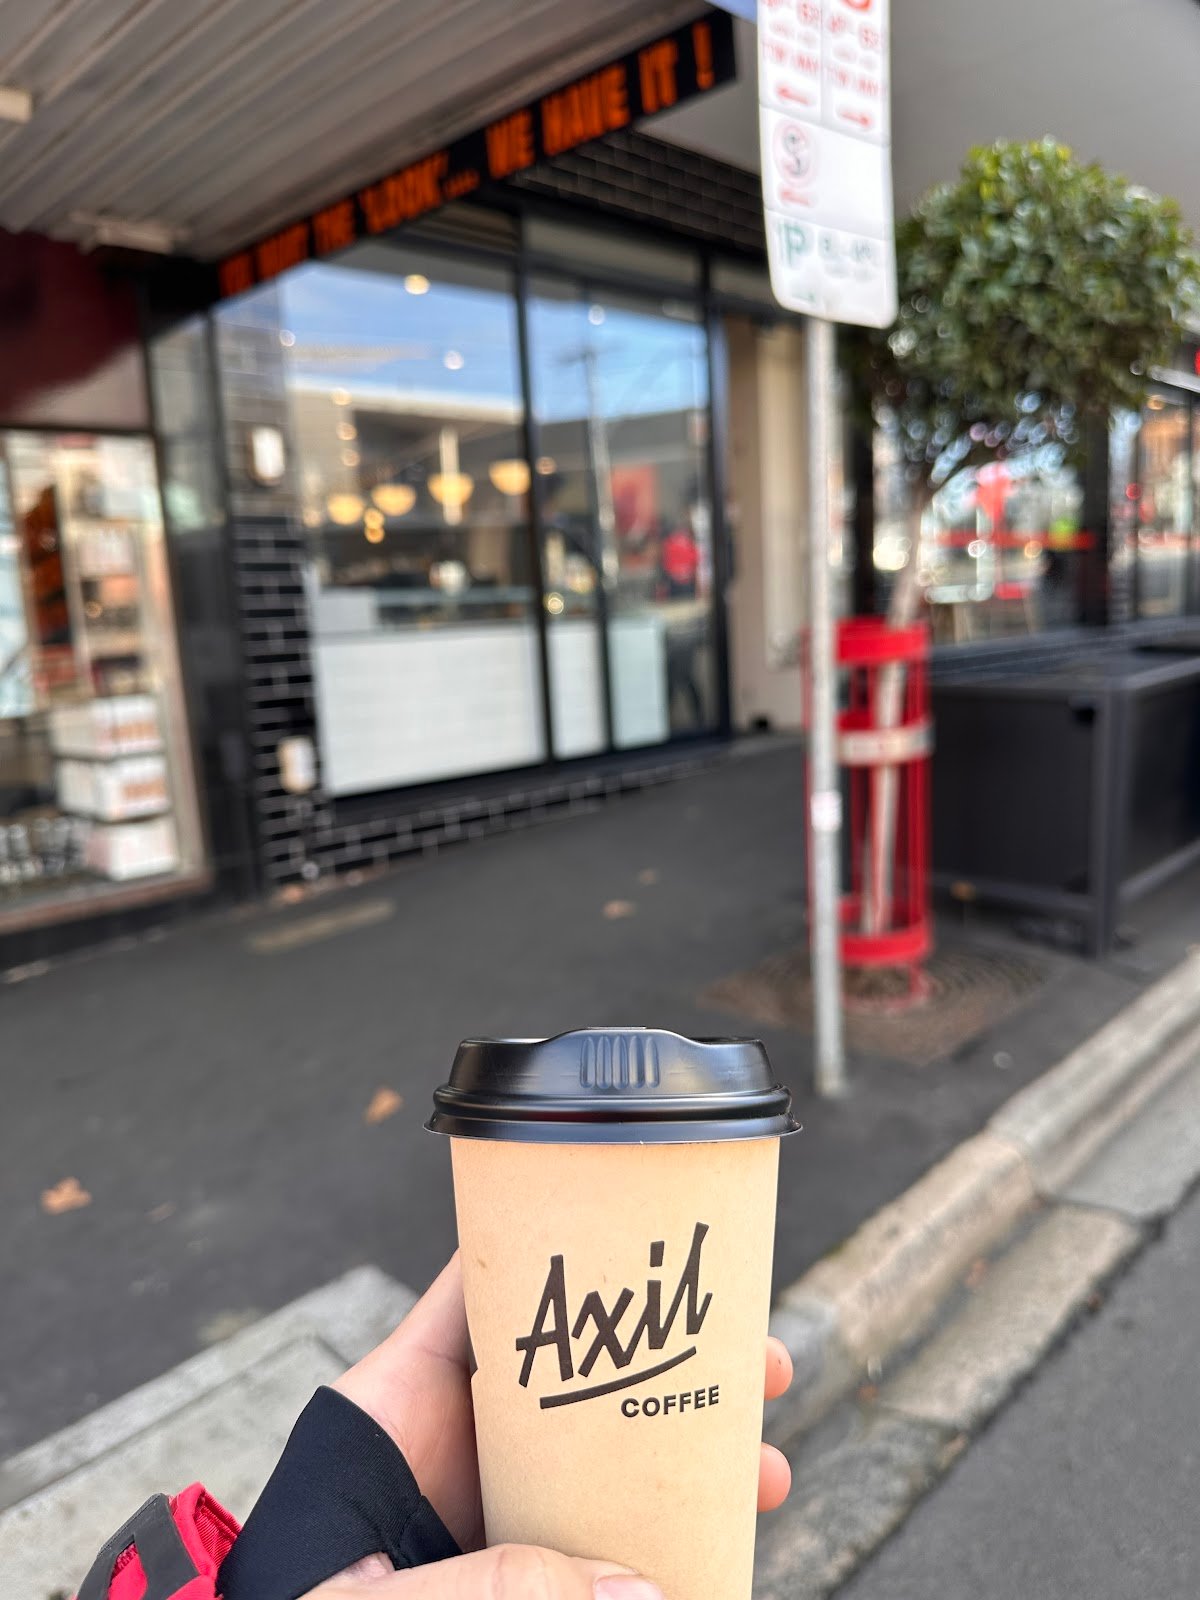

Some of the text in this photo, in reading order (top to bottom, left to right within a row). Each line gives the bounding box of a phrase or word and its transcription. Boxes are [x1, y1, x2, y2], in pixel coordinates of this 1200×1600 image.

[486, 107, 536, 180] WE
[541, 62, 631, 157] HAVE
[637, 38, 678, 115] IT
[692, 22, 715, 90] !
[515, 1221, 714, 1389] Axil
[620, 1384, 720, 1418] COFFEE
